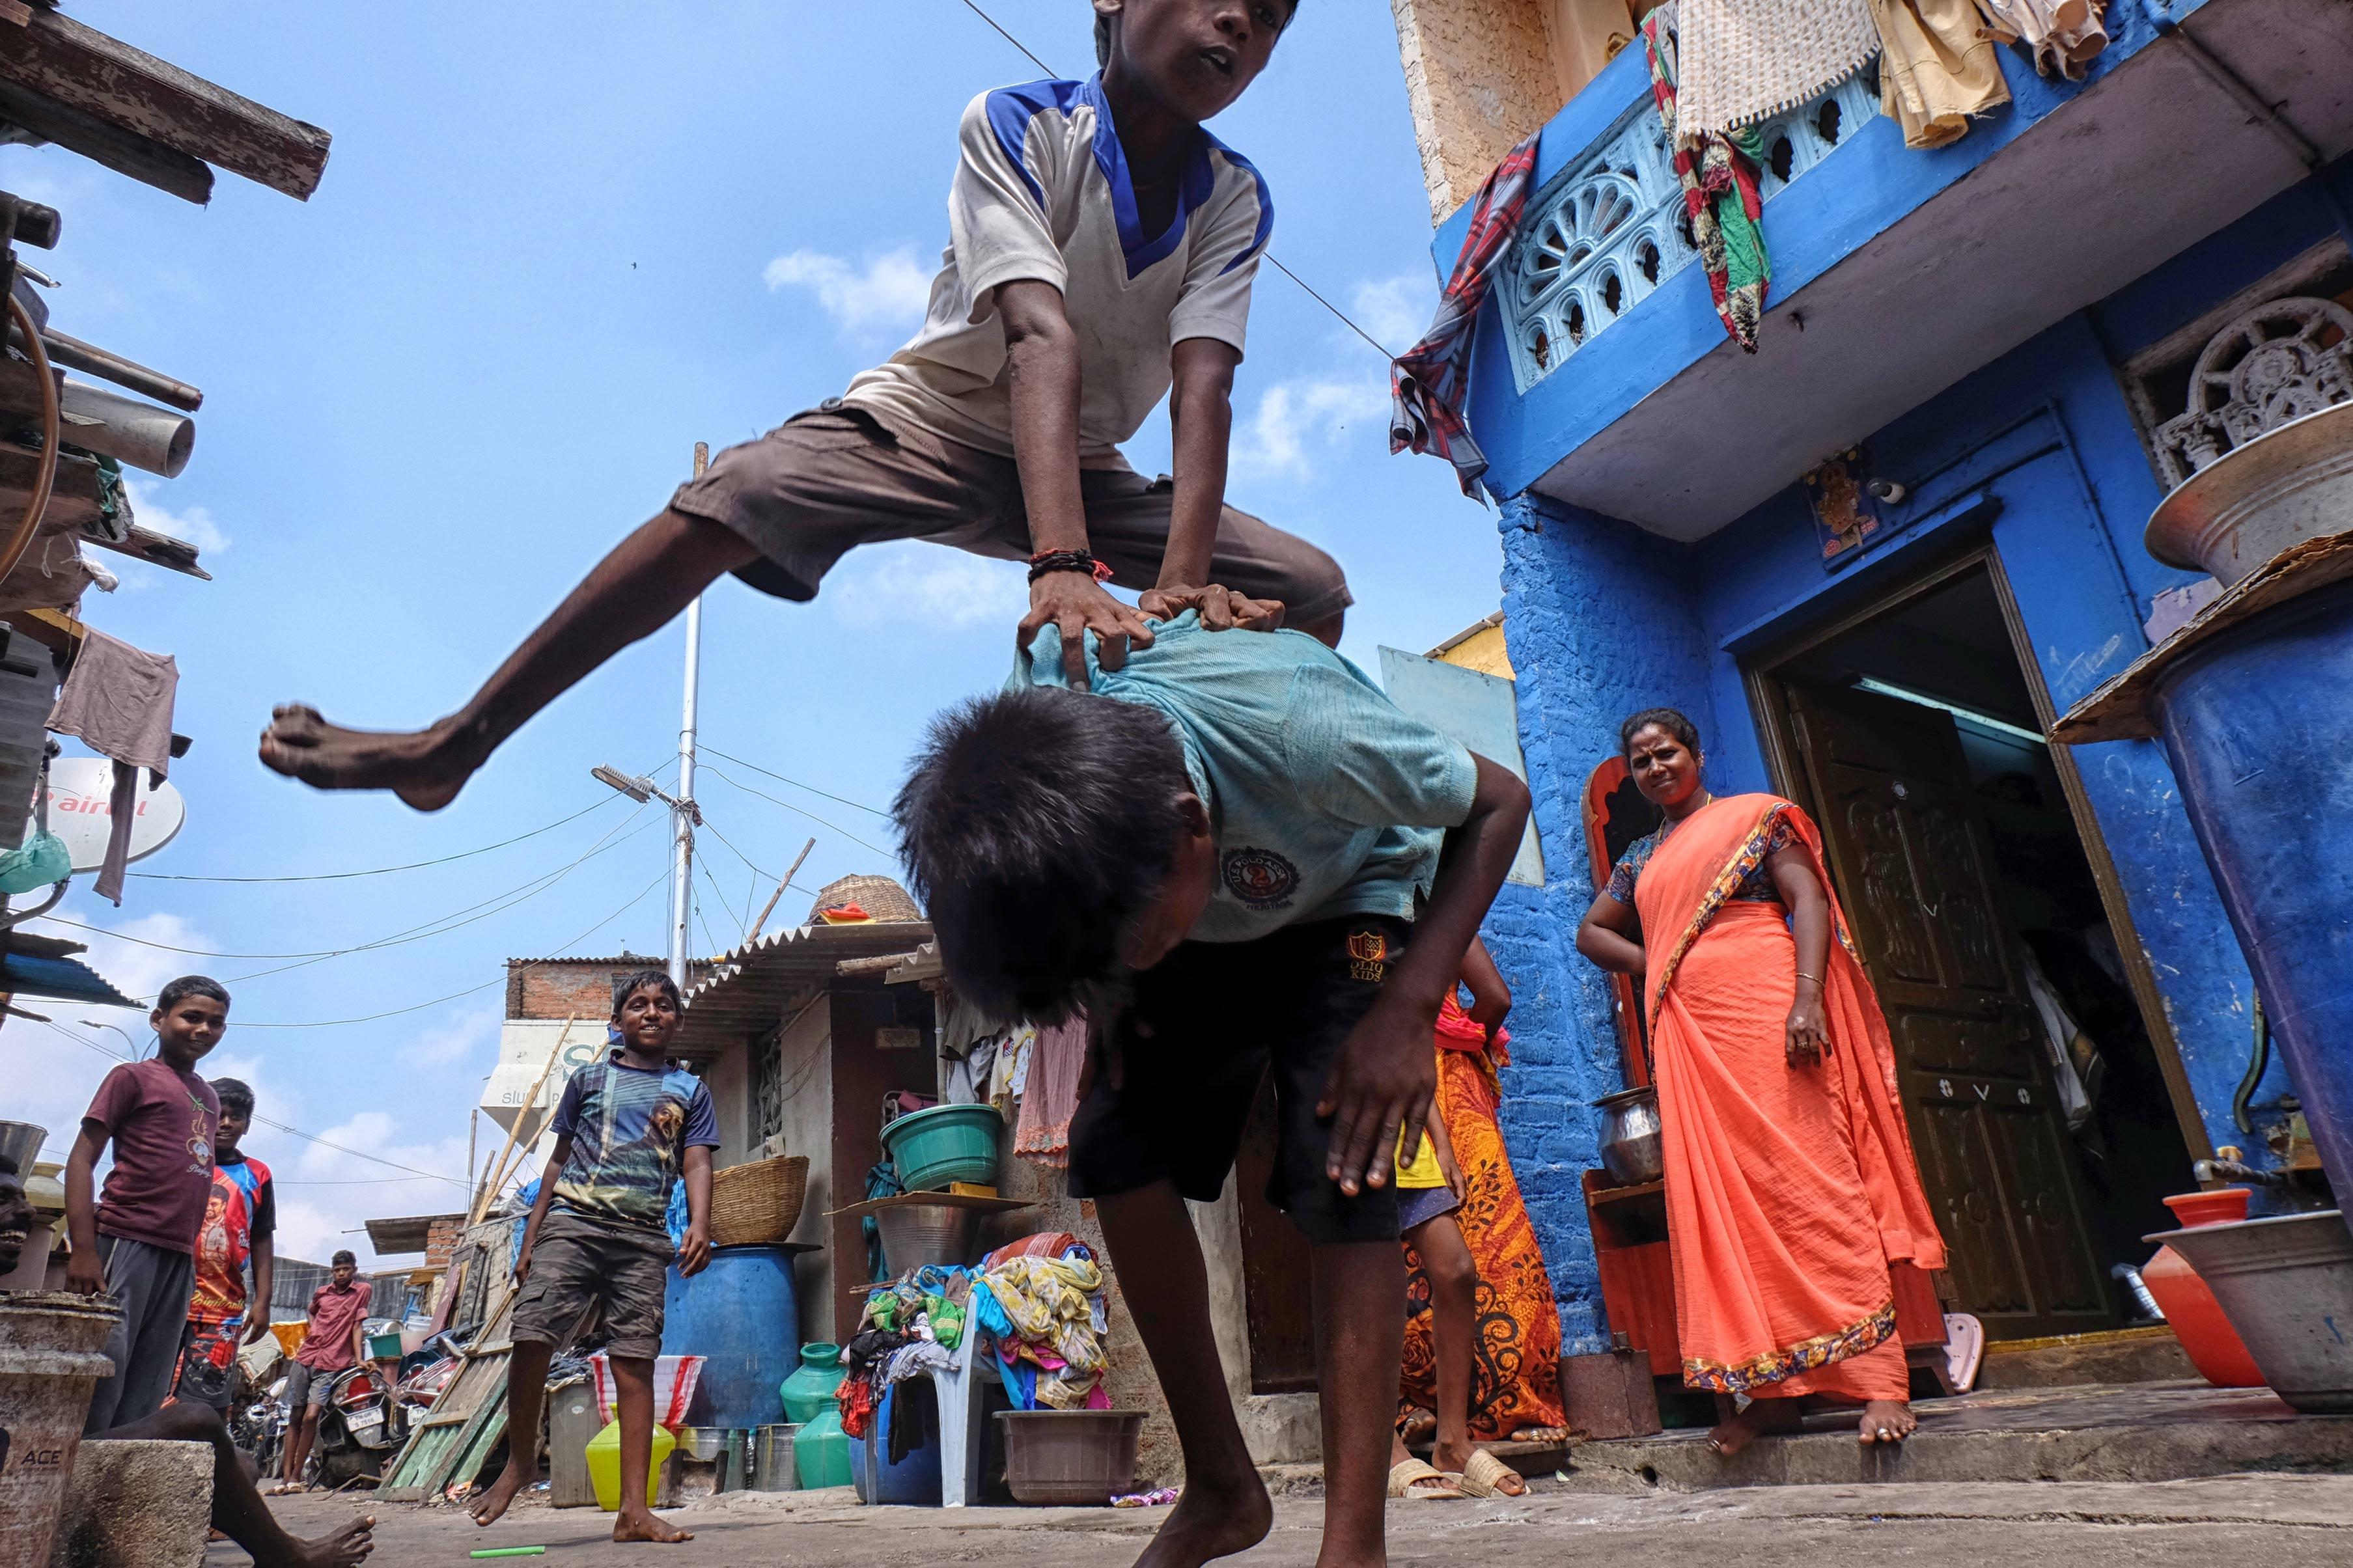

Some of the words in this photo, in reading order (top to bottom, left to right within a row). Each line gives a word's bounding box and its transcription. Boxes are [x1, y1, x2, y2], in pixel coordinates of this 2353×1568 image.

[58, 795, 146, 816] airl
[1234, 857, 1264, 868] POLO
[1350, 969, 1381, 982] KIDS
[501, 1090, 538, 1105] slu
[21, 1450, 63, 1465] ACE
